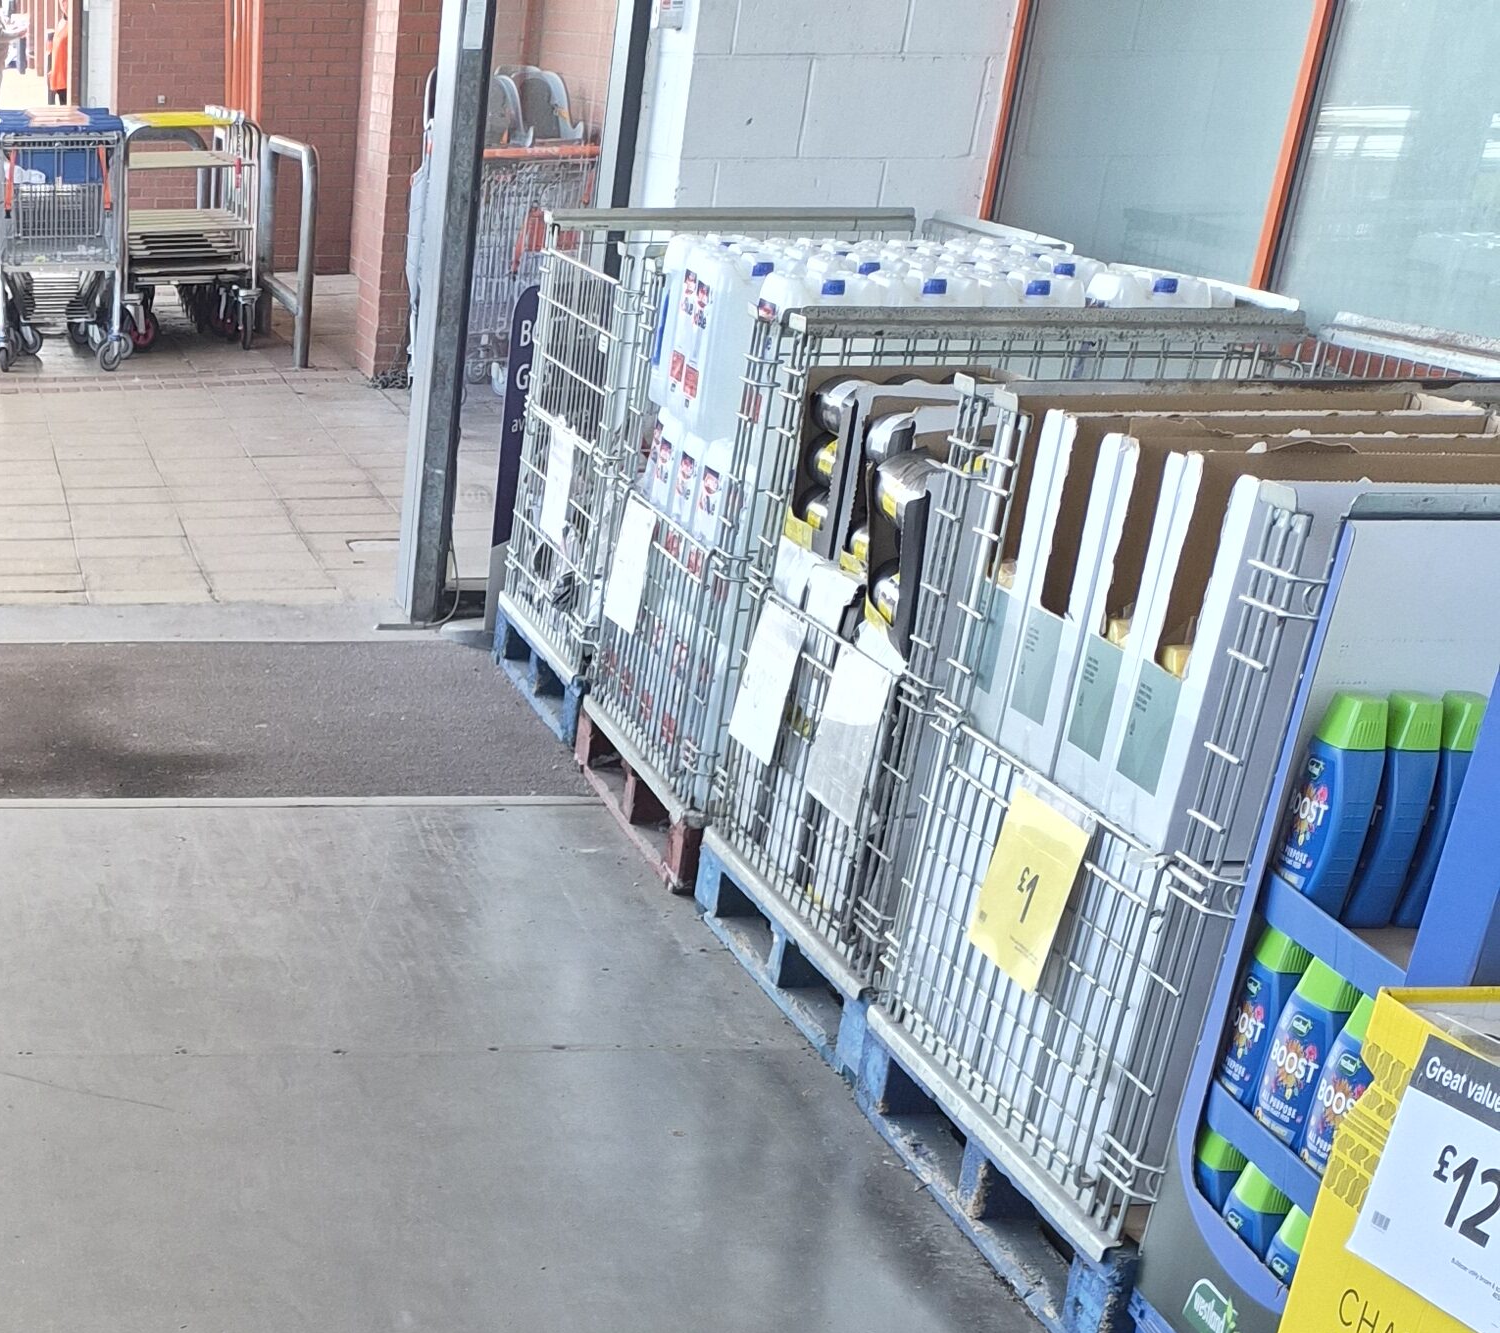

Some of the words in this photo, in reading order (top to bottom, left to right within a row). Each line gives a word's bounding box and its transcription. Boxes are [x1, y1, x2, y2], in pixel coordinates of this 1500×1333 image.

[1017, 866, 1040, 924] £1
[1234, 1006, 1265, 1043] OST
[1270, 1038, 1319, 1084] BOOST
[1426, 1056, 1467, 1101] Great
[1467, 1081, 1500, 1113] value
[1318, 1077, 1357, 1117] BOOS
[1433, 1144, 1500, 1249] £12
